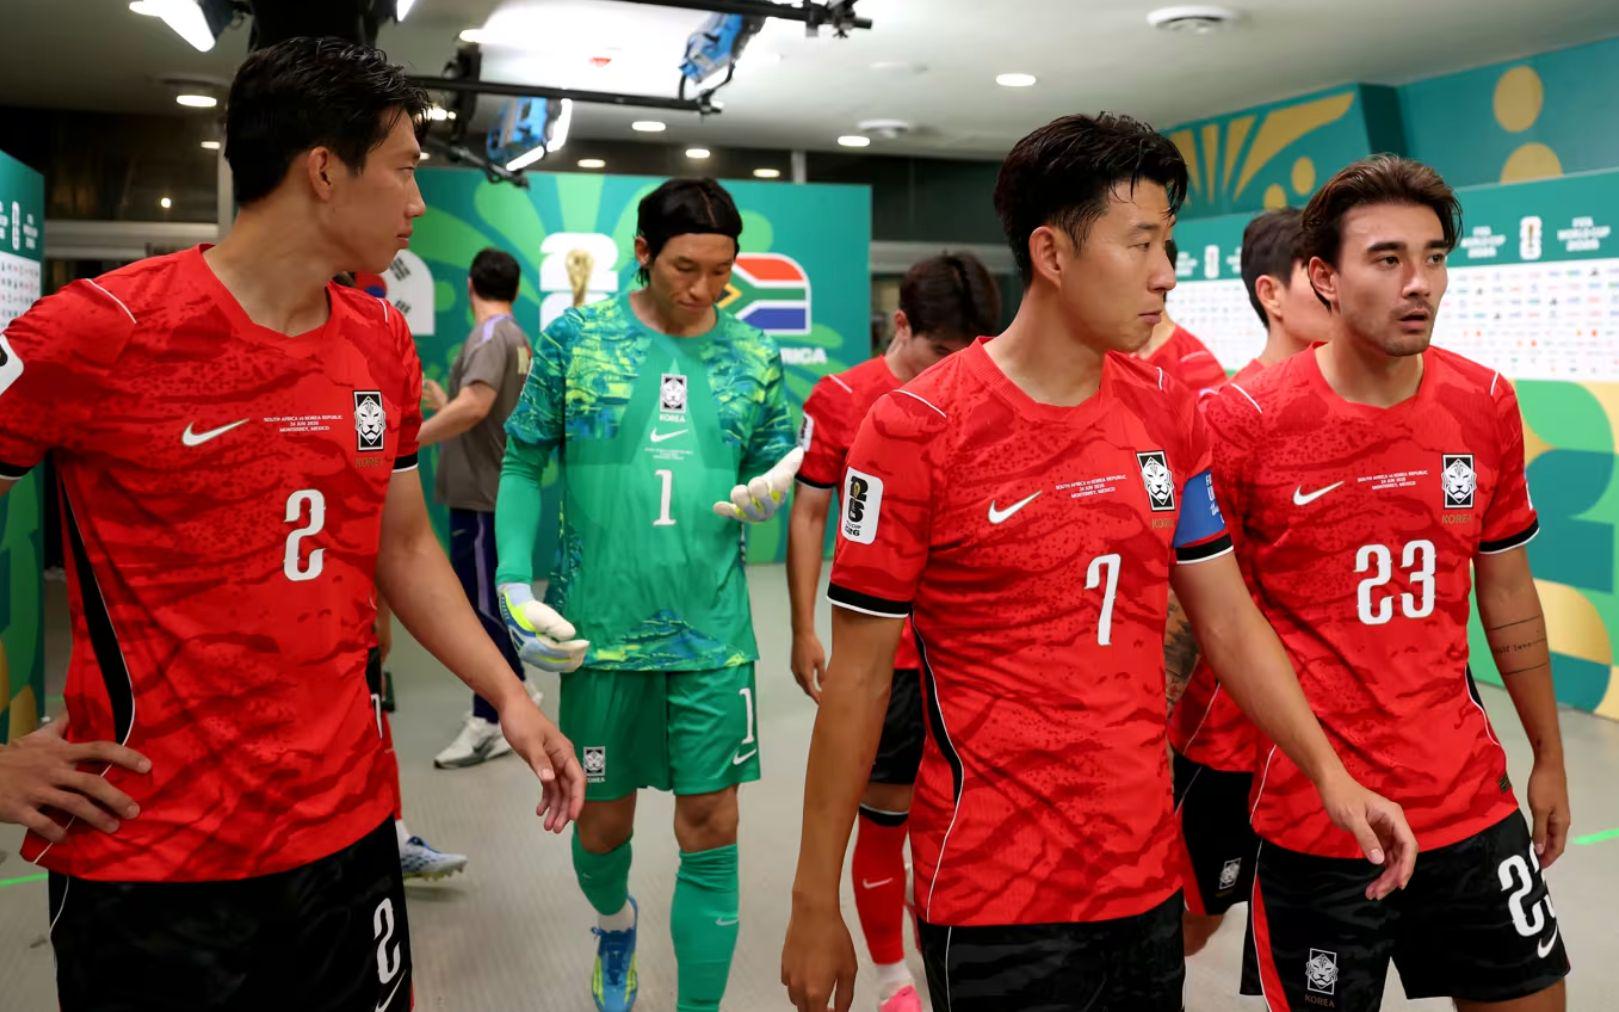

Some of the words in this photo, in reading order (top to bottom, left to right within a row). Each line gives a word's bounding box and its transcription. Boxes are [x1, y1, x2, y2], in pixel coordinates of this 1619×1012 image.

[780, 347, 827, 364] RICA
[283, 489, 327, 582] 2
[653, 469, 677, 526] 1
[1084, 553, 1121, 646] 7
[1353, 540, 1436, 625] 23
[739, 688, 754, 744] 1
[374, 898, 401, 984] 2
